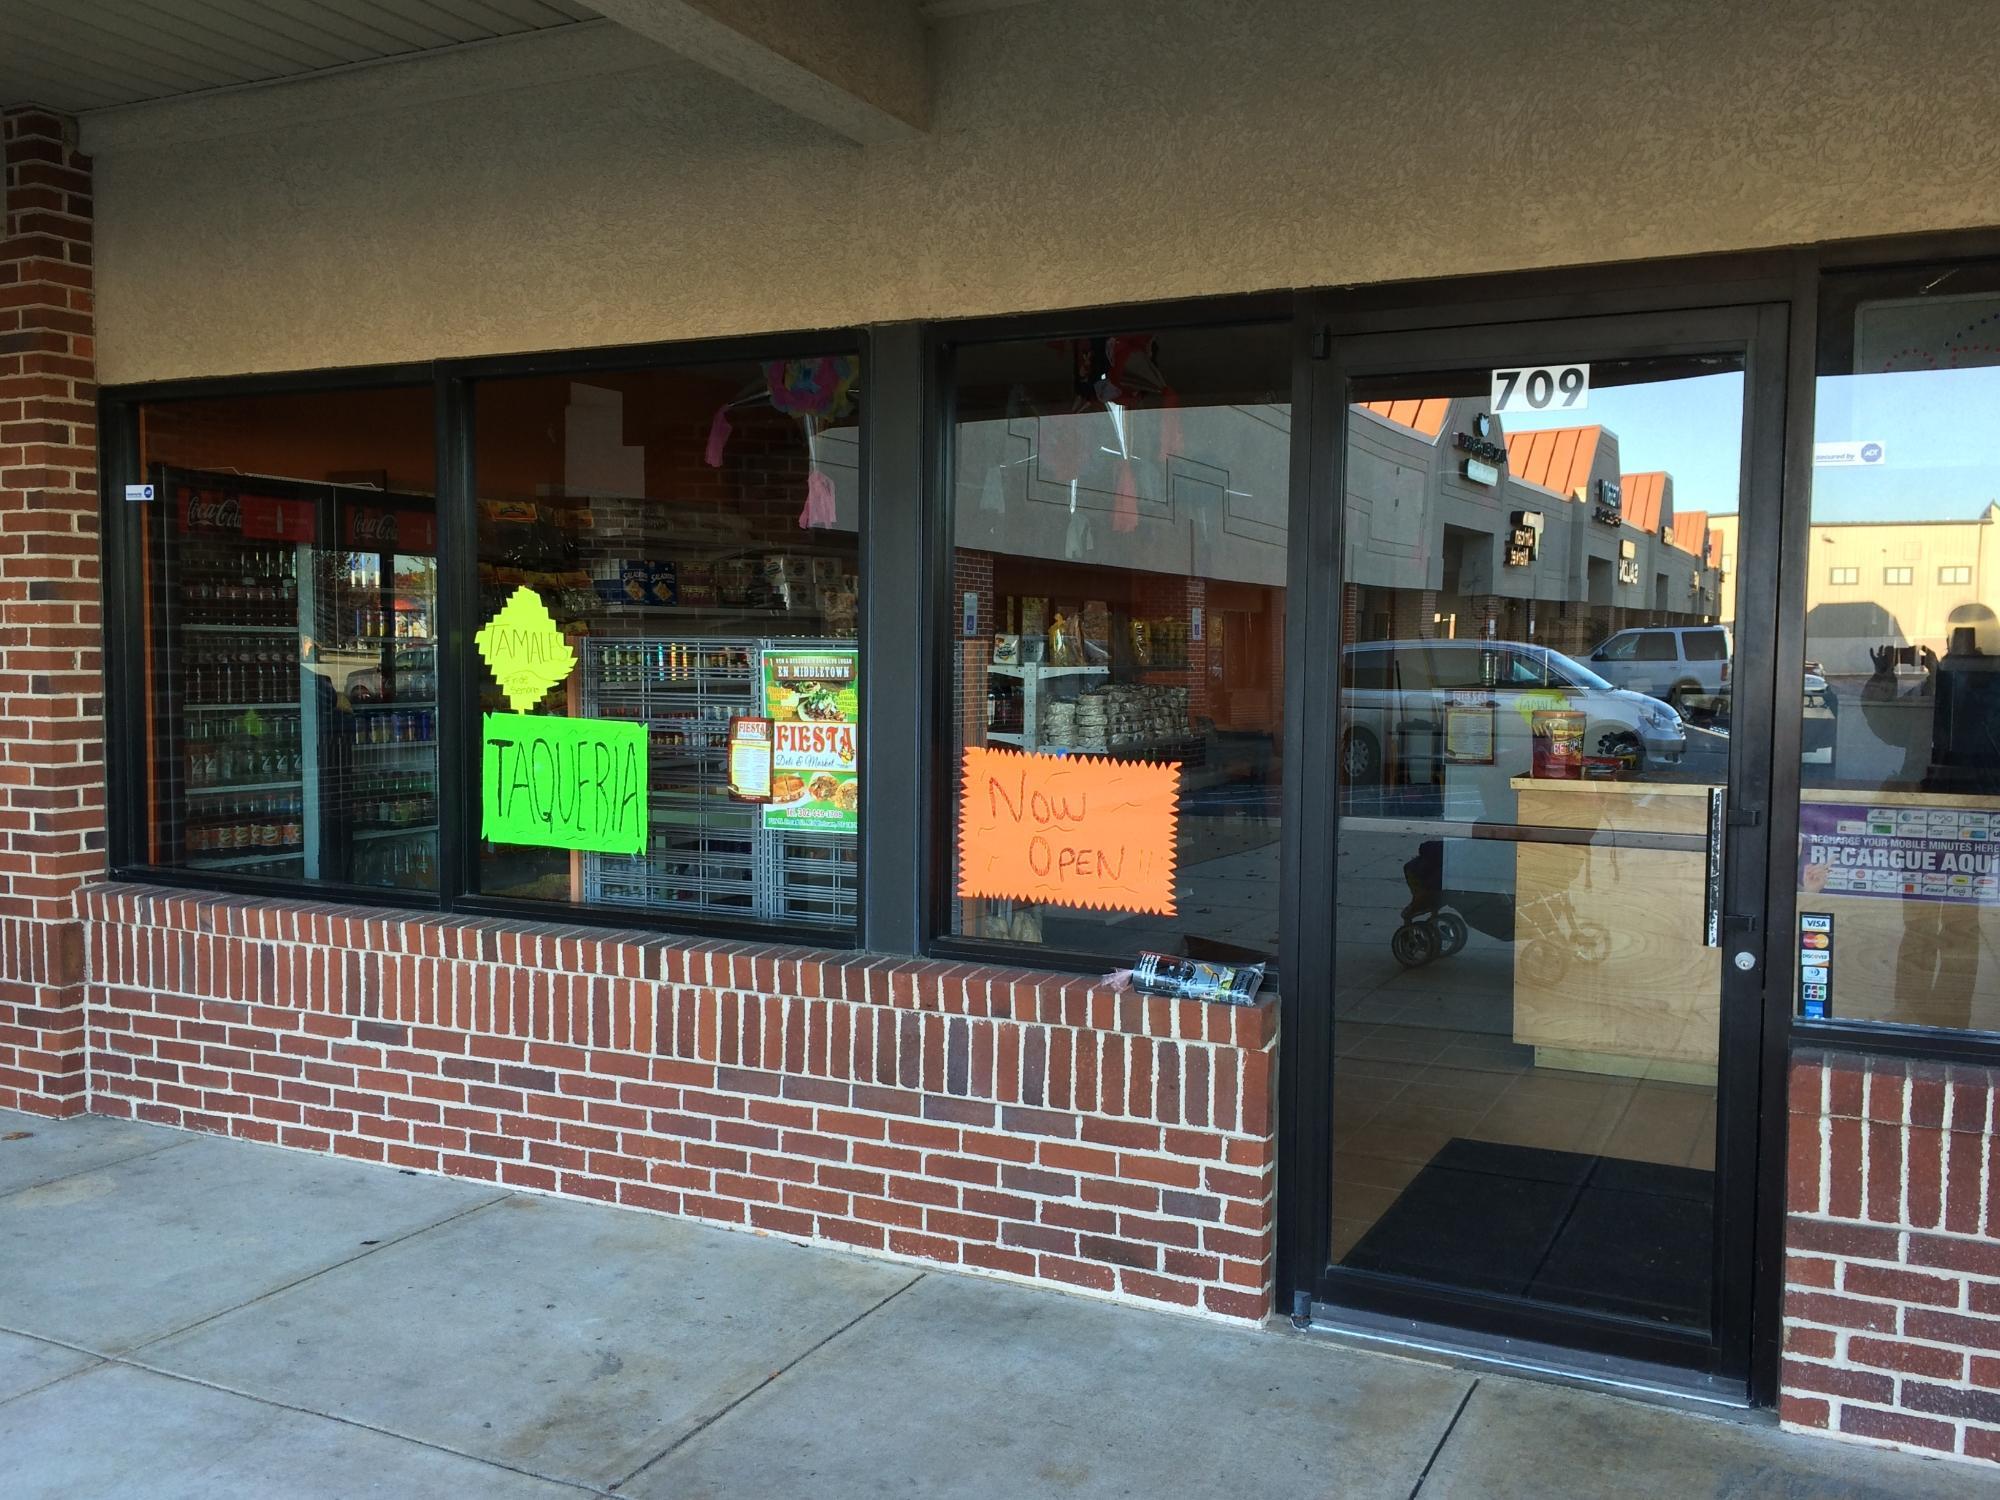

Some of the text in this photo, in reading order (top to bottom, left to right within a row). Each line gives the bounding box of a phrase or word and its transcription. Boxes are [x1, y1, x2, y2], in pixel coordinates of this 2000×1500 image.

[1495, 368, 1584, 410] 709
[487, 624, 569, 664] TAMALES
[778, 666, 850, 678] EN MIDDLETOWN
[739, 723, 766, 735] FIESTA
[776, 725, 854, 753] FIESTA
[776, 754, 794, 766] Deli
[804, 755, 835, 768] Market
[1810, 834, 2000, 853] RECHARGE YOUR MOBILE MINUTES HERE
[1810, 845, 1937, 871] RECARGUE
[1806, 919, 1827, 928] VISA
